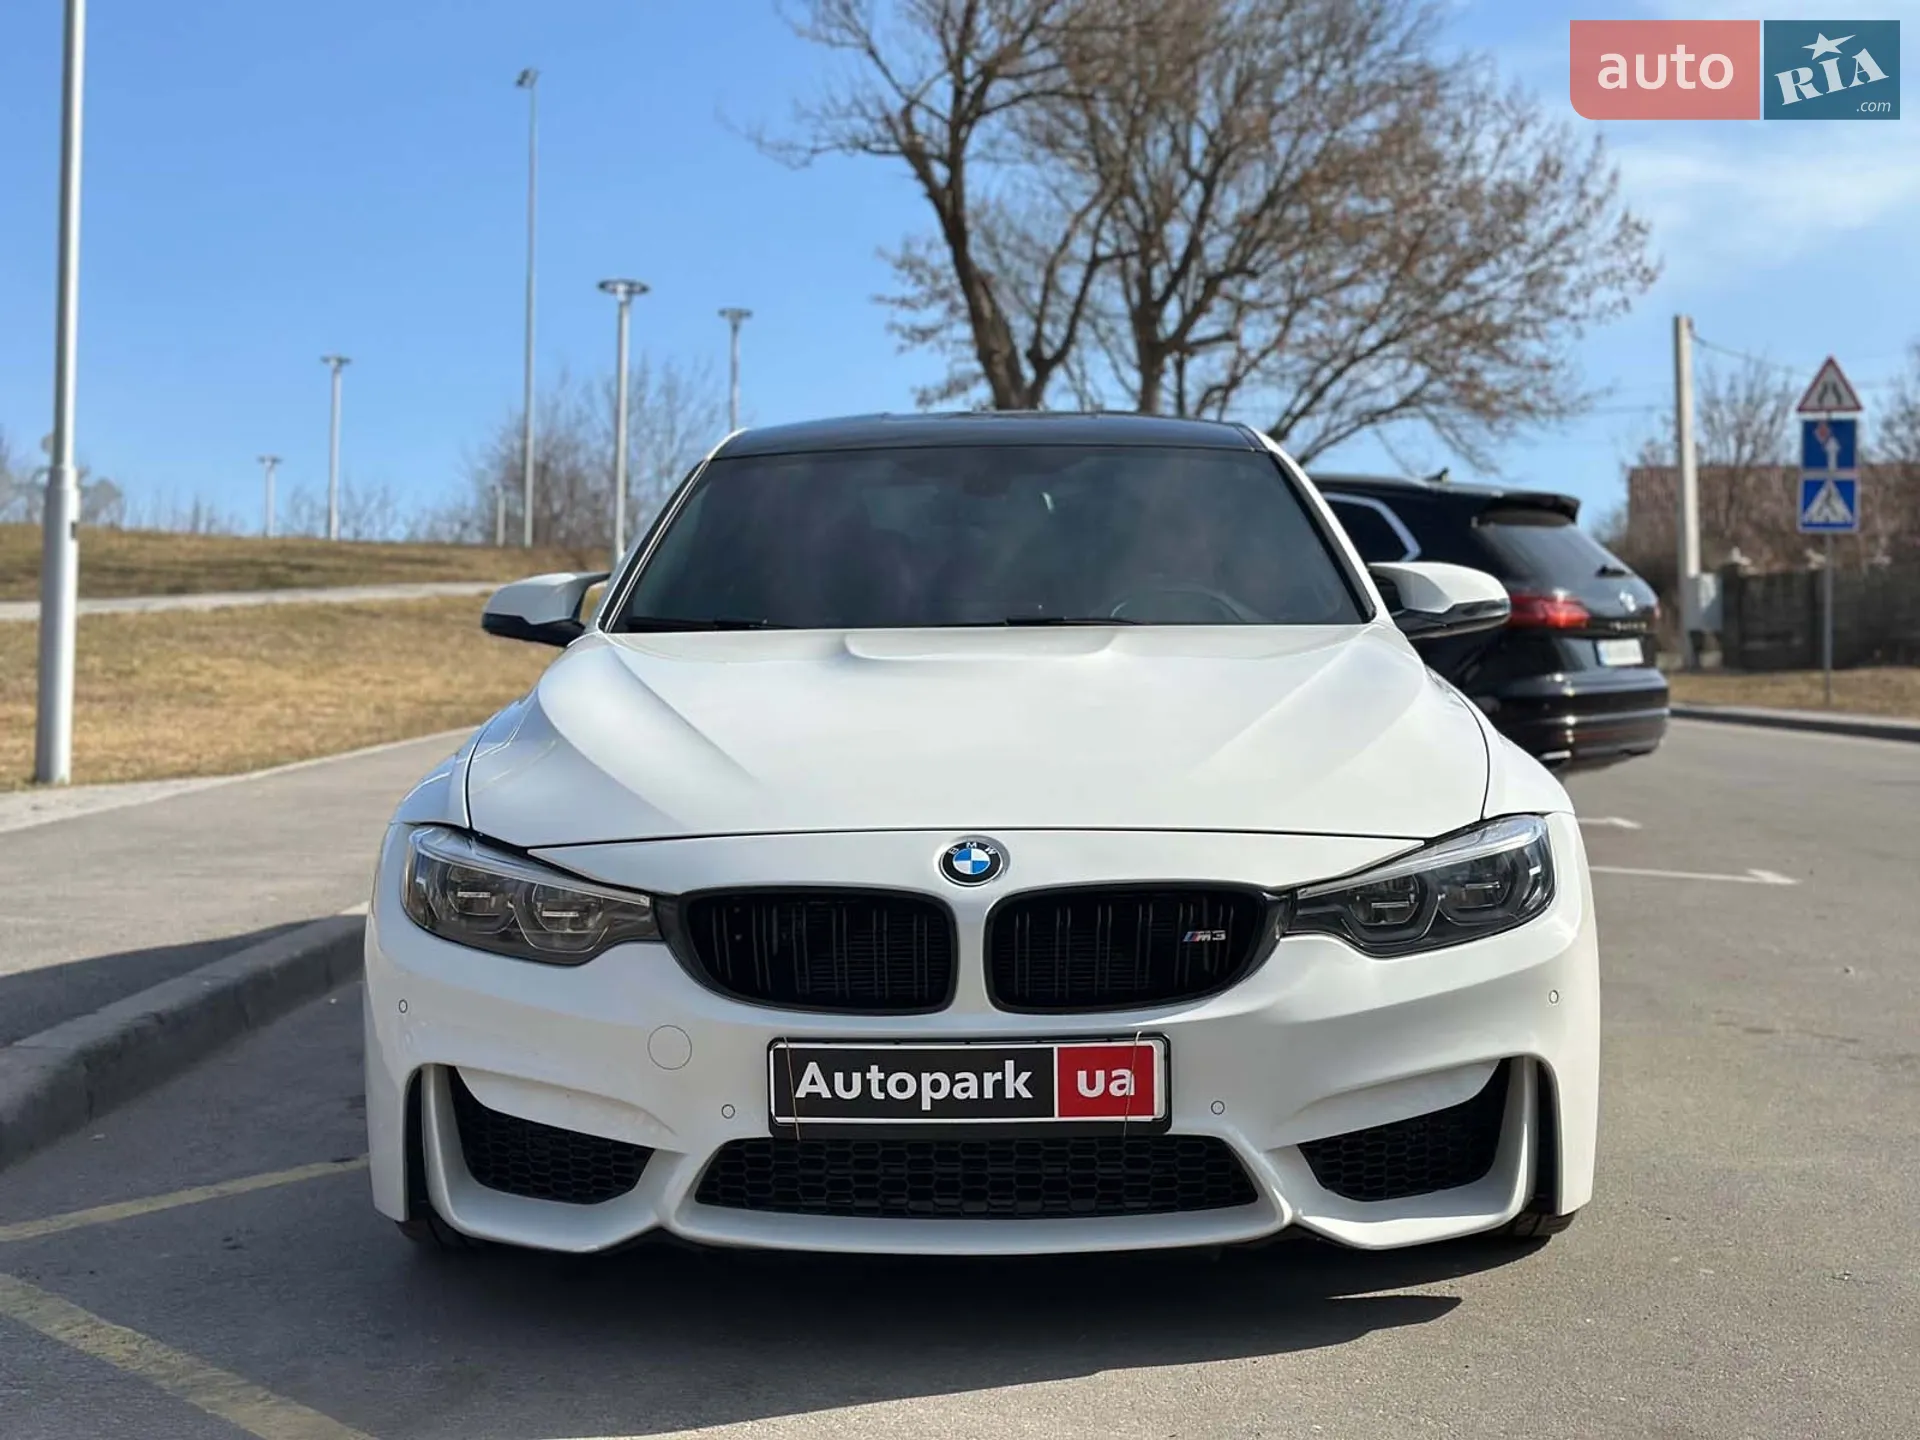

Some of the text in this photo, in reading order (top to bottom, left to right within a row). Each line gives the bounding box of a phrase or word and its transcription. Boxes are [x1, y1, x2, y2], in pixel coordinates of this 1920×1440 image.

[948, 842, 998, 855] BMW
[795, 1060, 1136, 1111] Autopark ua
